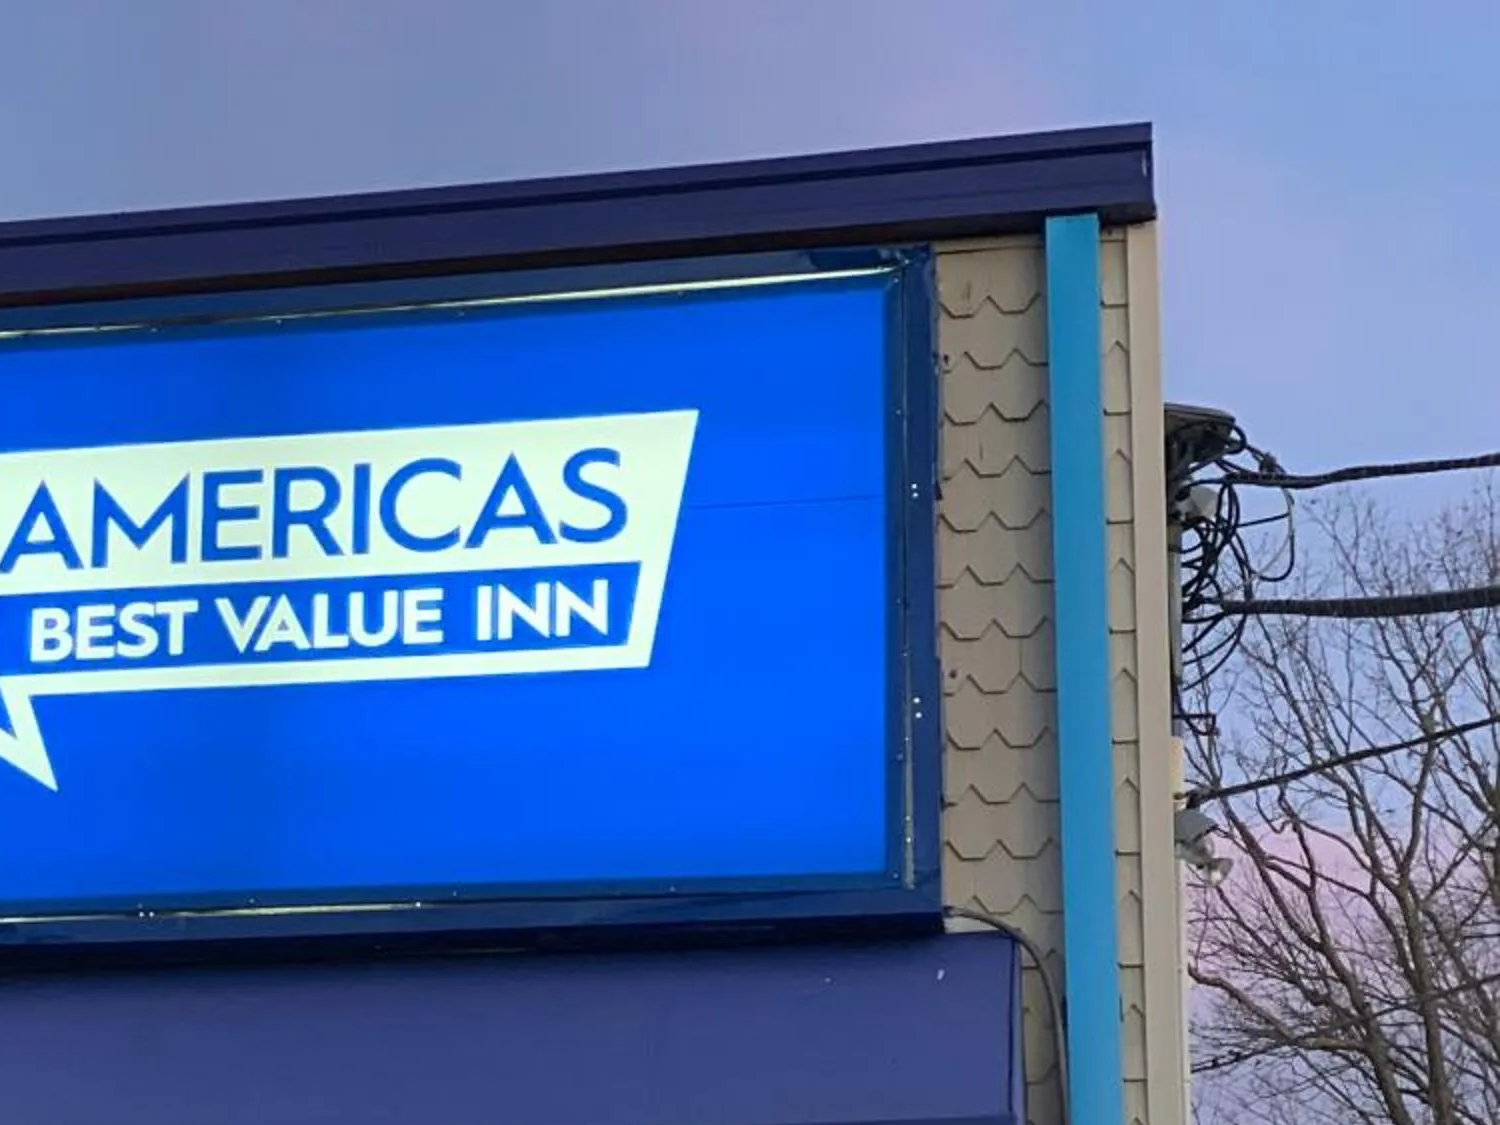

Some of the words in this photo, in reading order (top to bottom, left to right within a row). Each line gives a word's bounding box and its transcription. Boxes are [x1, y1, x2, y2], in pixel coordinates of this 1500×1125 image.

[29, 600, 198, 663] BEST
[214, 587, 443, 653] VALUE
[476, 577, 609, 641] INN
